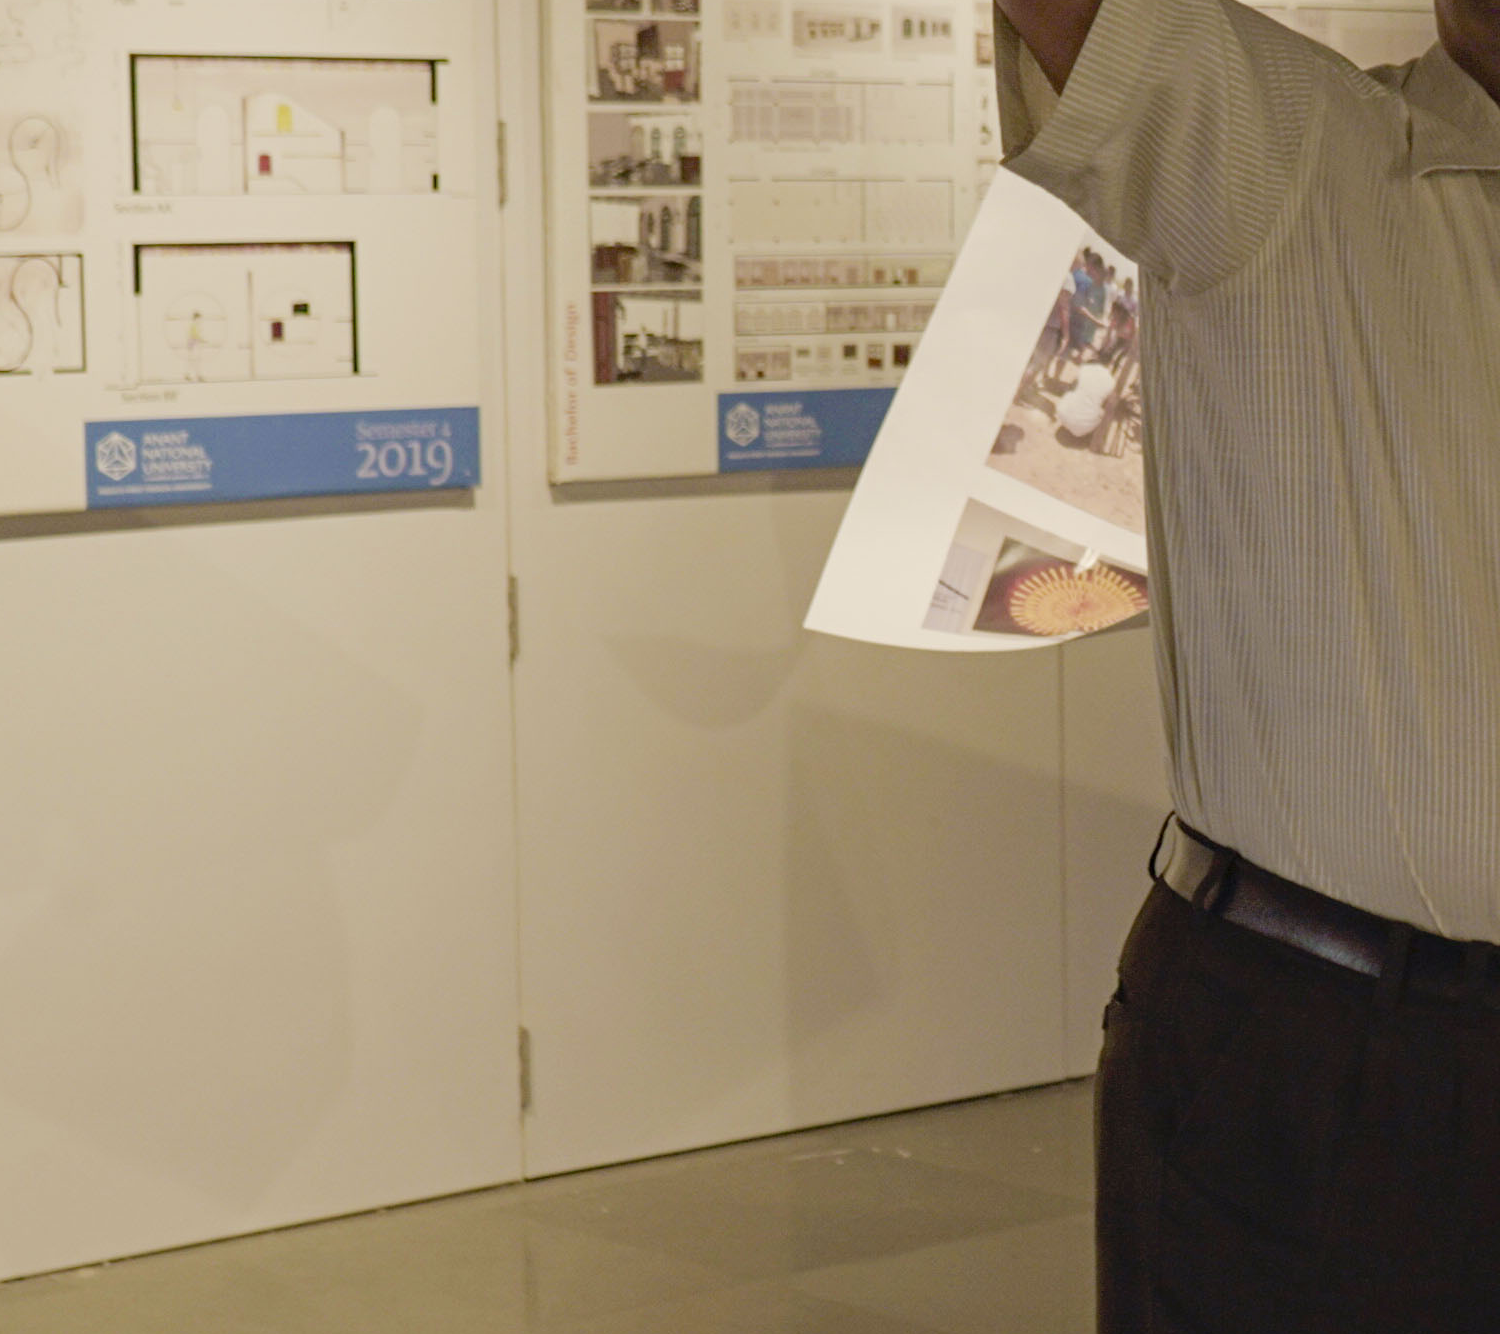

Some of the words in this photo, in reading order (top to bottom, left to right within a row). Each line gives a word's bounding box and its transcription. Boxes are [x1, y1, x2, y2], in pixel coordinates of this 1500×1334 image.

[563, 302, 580, 361] Design
[563, 368, 578, 386] of
[356, 421, 437, 441] Semester
[564, 391, 579, 466] Bachelor
[142, 430, 190, 447] ANANT
[142, 444, 210, 462] NATIONAL
[356, 439, 454, 485] 2019
[142, 458, 214, 476] UNIVERSITY
